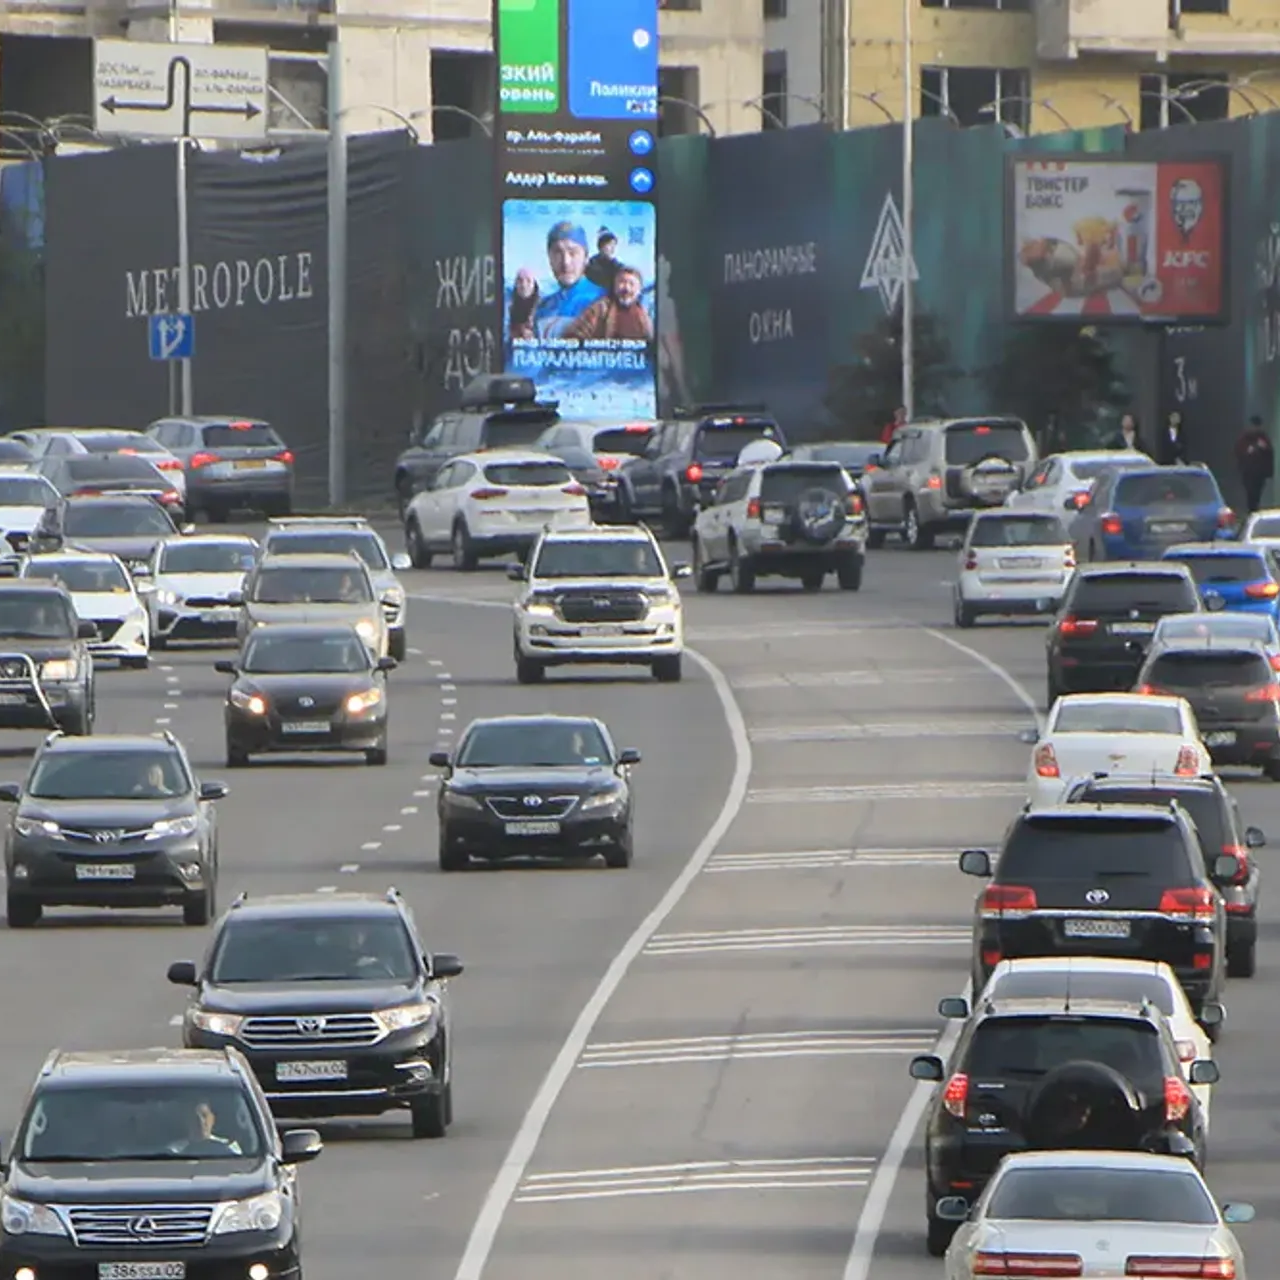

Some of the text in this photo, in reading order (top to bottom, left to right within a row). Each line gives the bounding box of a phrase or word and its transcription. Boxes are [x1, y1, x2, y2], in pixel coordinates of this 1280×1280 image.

[1027, 176, 1089, 192] ТВИСТЕР
[1025, 195, 1063, 209] БОКС
[1162, 251, 1209, 268] KFC
[749, 309, 794, 343] ОКНА
